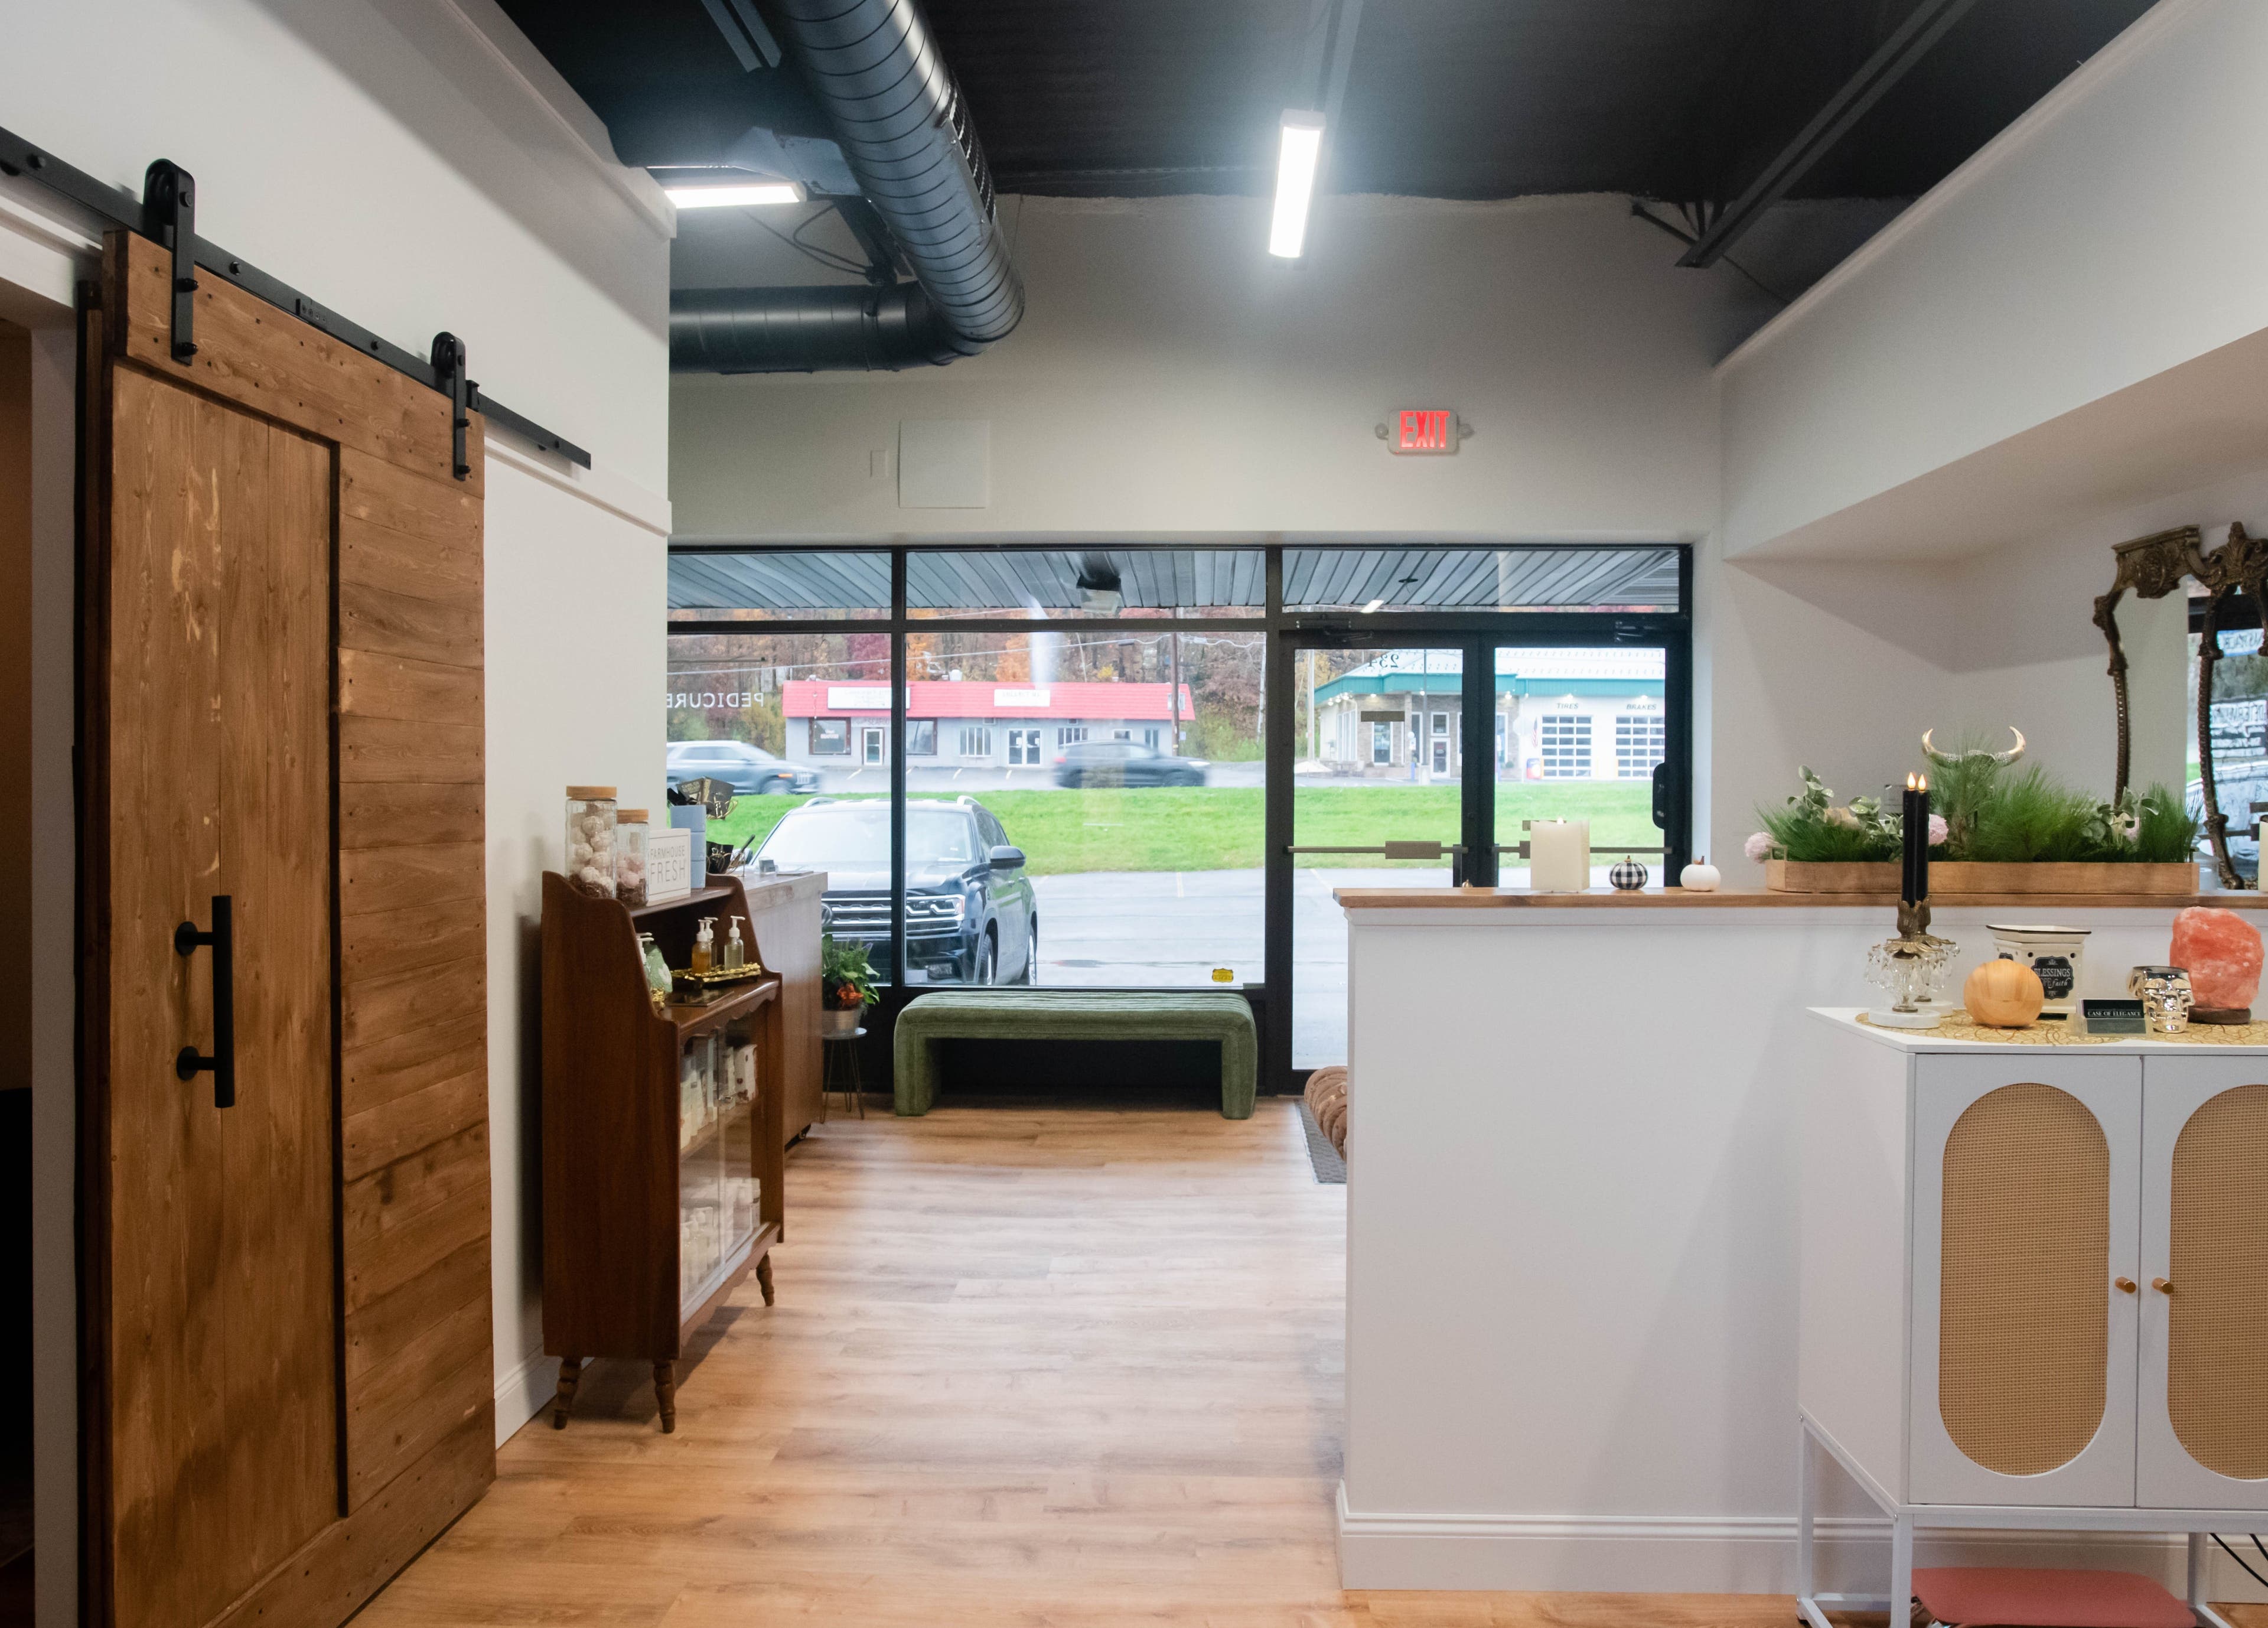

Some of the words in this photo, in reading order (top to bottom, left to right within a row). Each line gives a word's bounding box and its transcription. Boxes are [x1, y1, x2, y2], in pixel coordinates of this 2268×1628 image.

[1400, 411, 1450, 448] EXIT
[650, 845, 685, 860] FARMHOUSE
[650, 859, 686, 884] FRESH
[2048, 978, 2071, 989] faith
